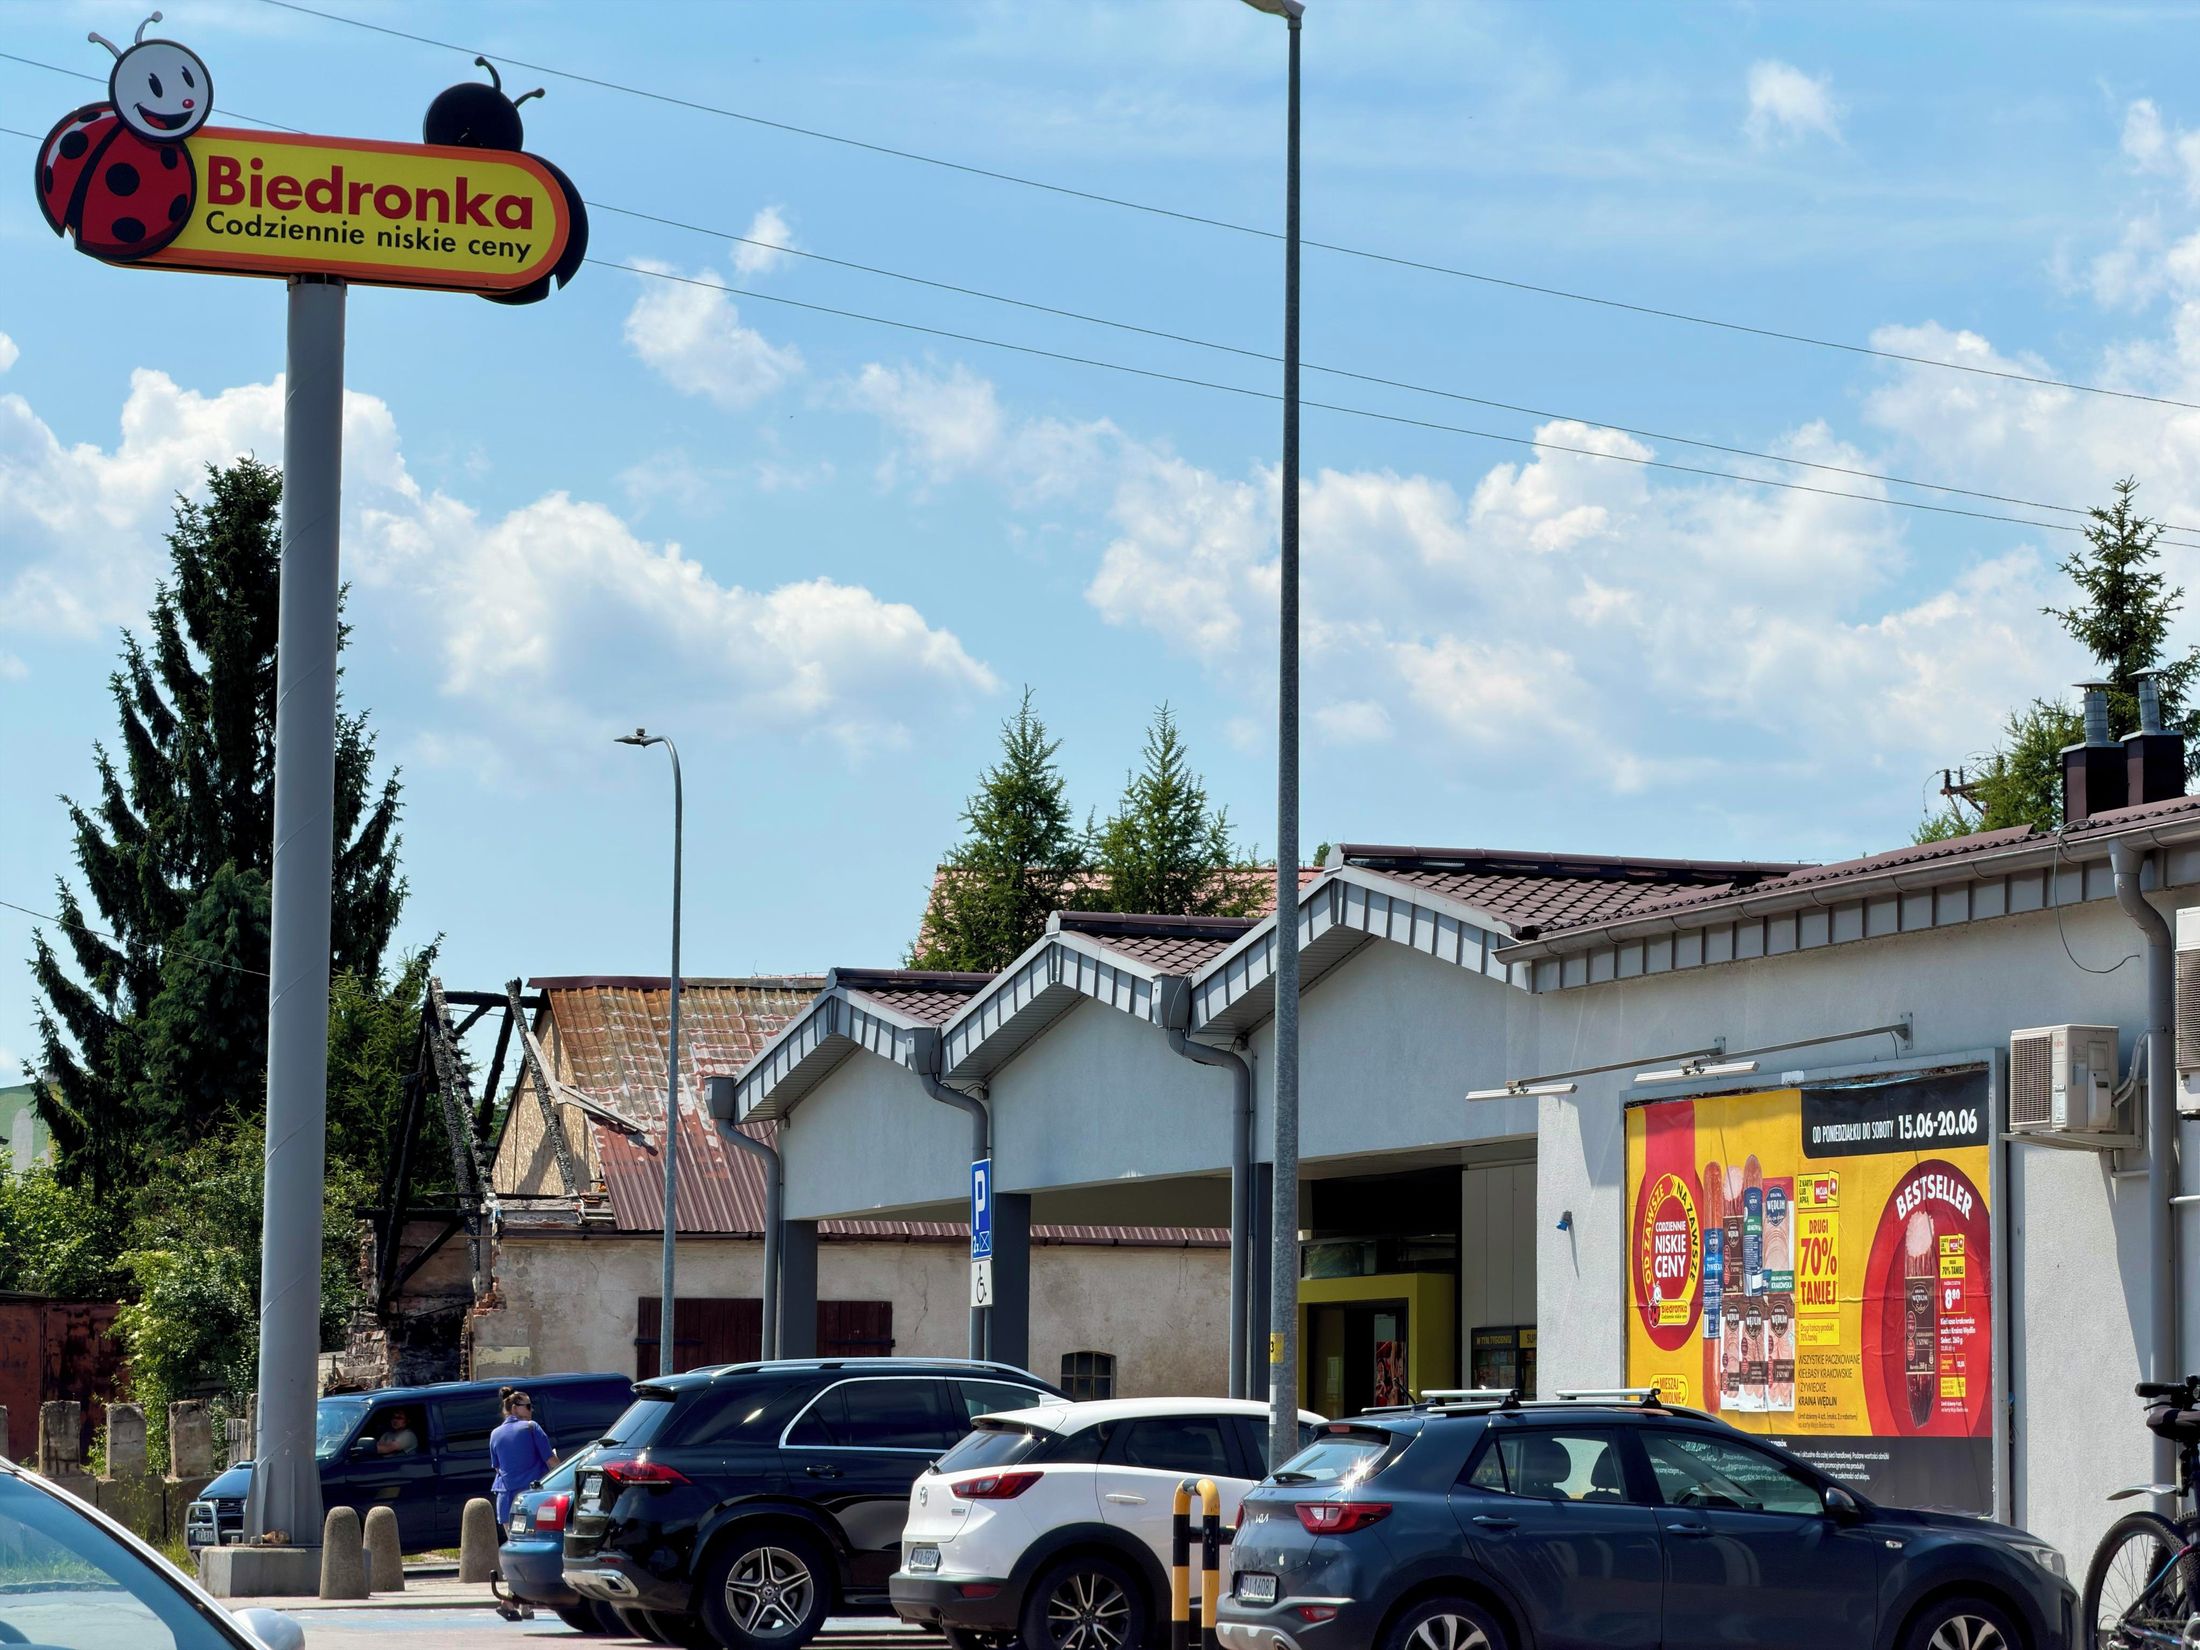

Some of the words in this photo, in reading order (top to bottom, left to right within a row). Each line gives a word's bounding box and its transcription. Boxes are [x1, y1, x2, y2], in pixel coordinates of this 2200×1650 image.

[207, 155, 533, 230] Biedronka
[206, 210, 365, 245] Codziennie
[377, 225, 456, 253] niskie
[468, 238, 532, 263] ceny
[1812, 1126, 1821, 1144] OD
[1862, 1122, 1871, 1140] DO
[1871, 1119, 1894, 1139] SOBOTY
[1898, 1108, 1978, 1140] 15.06-20.06
[974, 1169, 986, 1230] P
[1644, 1183, 1665, 1252] ZAWSZE
[1896, 1174, 1973, 1221] BESTSELLER
[1655, 1220, 1687, 1233] CODZIENNIE
[1655, 1233, 1687, 1254] NISKIE
[1676, 1182, 1687, 1206] NA
[1686, 1205, 1699, 1283] ZAWSZE
[1808, 1218, 1829, 1234] DRUGI
[1654, 1254, 1687, 1279] CENY
[1800, 1236, 1838, 1277] 70%
[1800, 1280, 1837, 1306] TANIEJ
